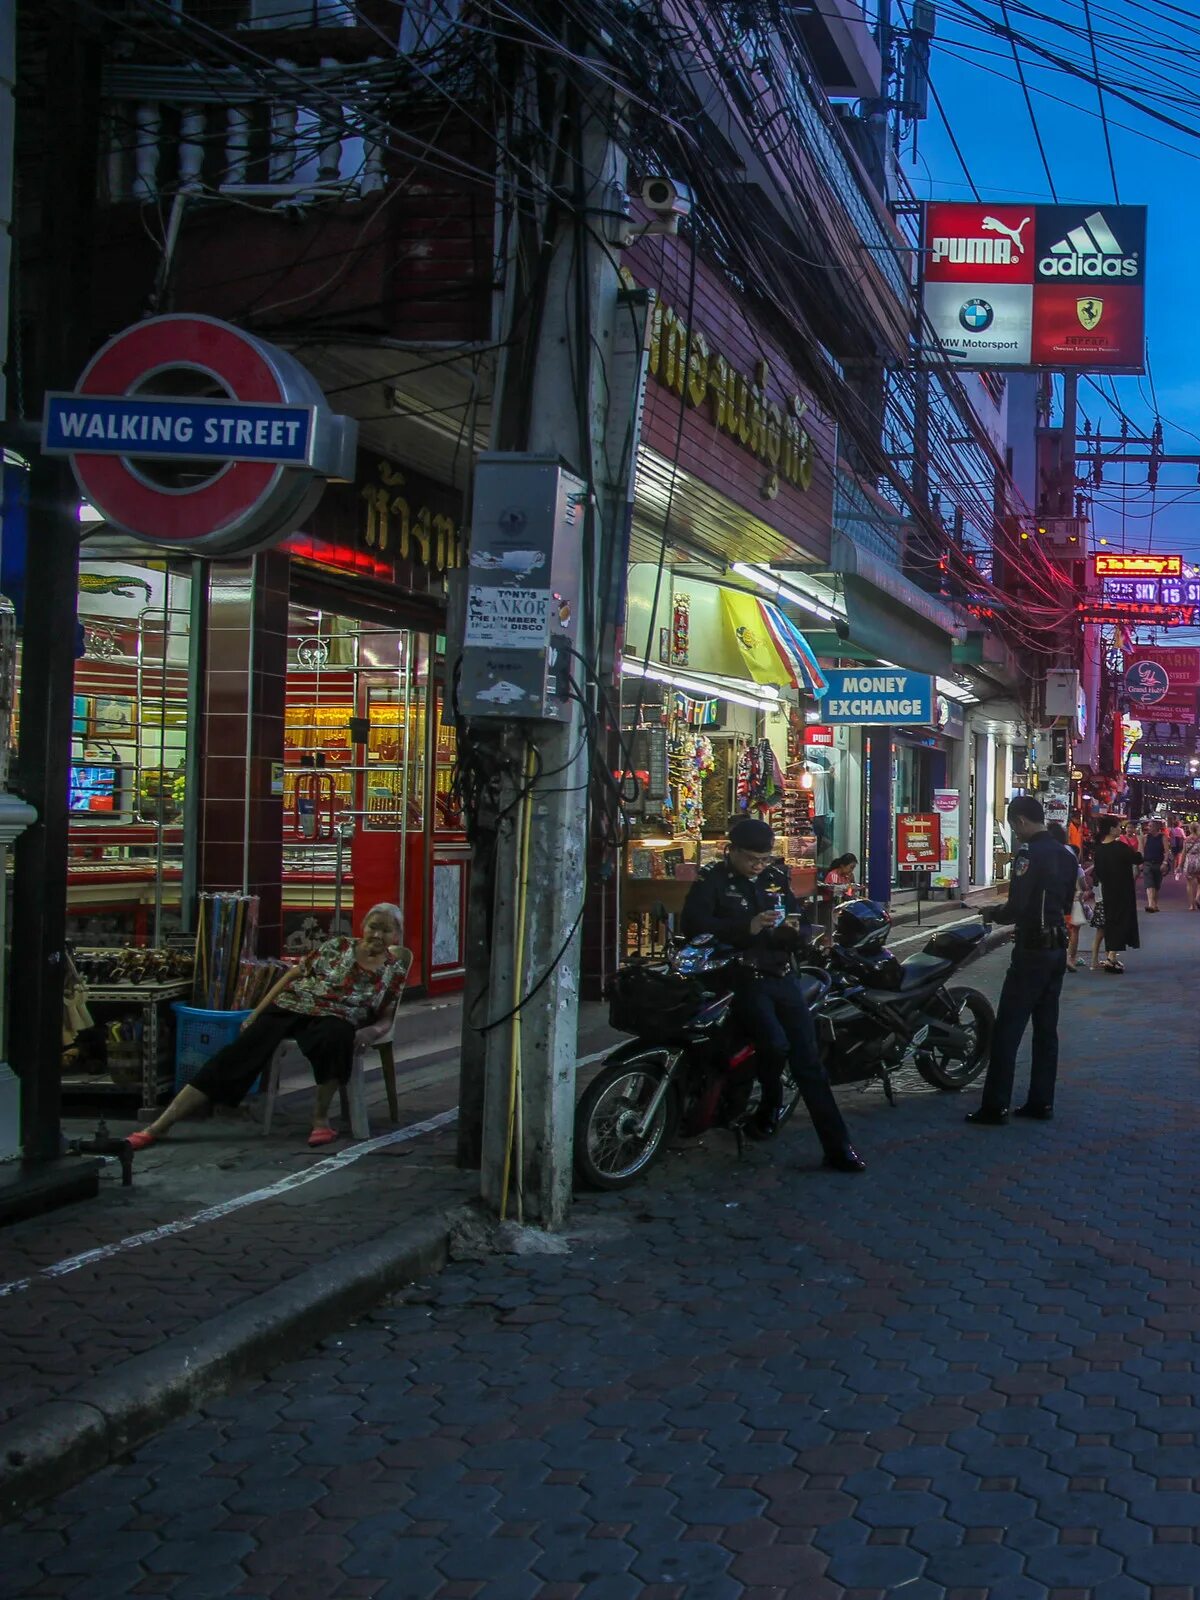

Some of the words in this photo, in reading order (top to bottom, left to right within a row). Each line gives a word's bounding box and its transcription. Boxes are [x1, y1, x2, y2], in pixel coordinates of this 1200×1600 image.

[931, 238, 1012, 264] PUMA
[1038, 253, 1138, 277] adidas
[962, 339, 1019, 350] Motorsport
[58, 412, 193, 442] WALKING
[204, 418, 300, 446] STREET
[1162, 588, 1180, 603] 15
[842, 677, 908, 693] MONEY
[1128, 685, 1147, 693] Grand
[828, 700, 922, 716] EXCHANGE
